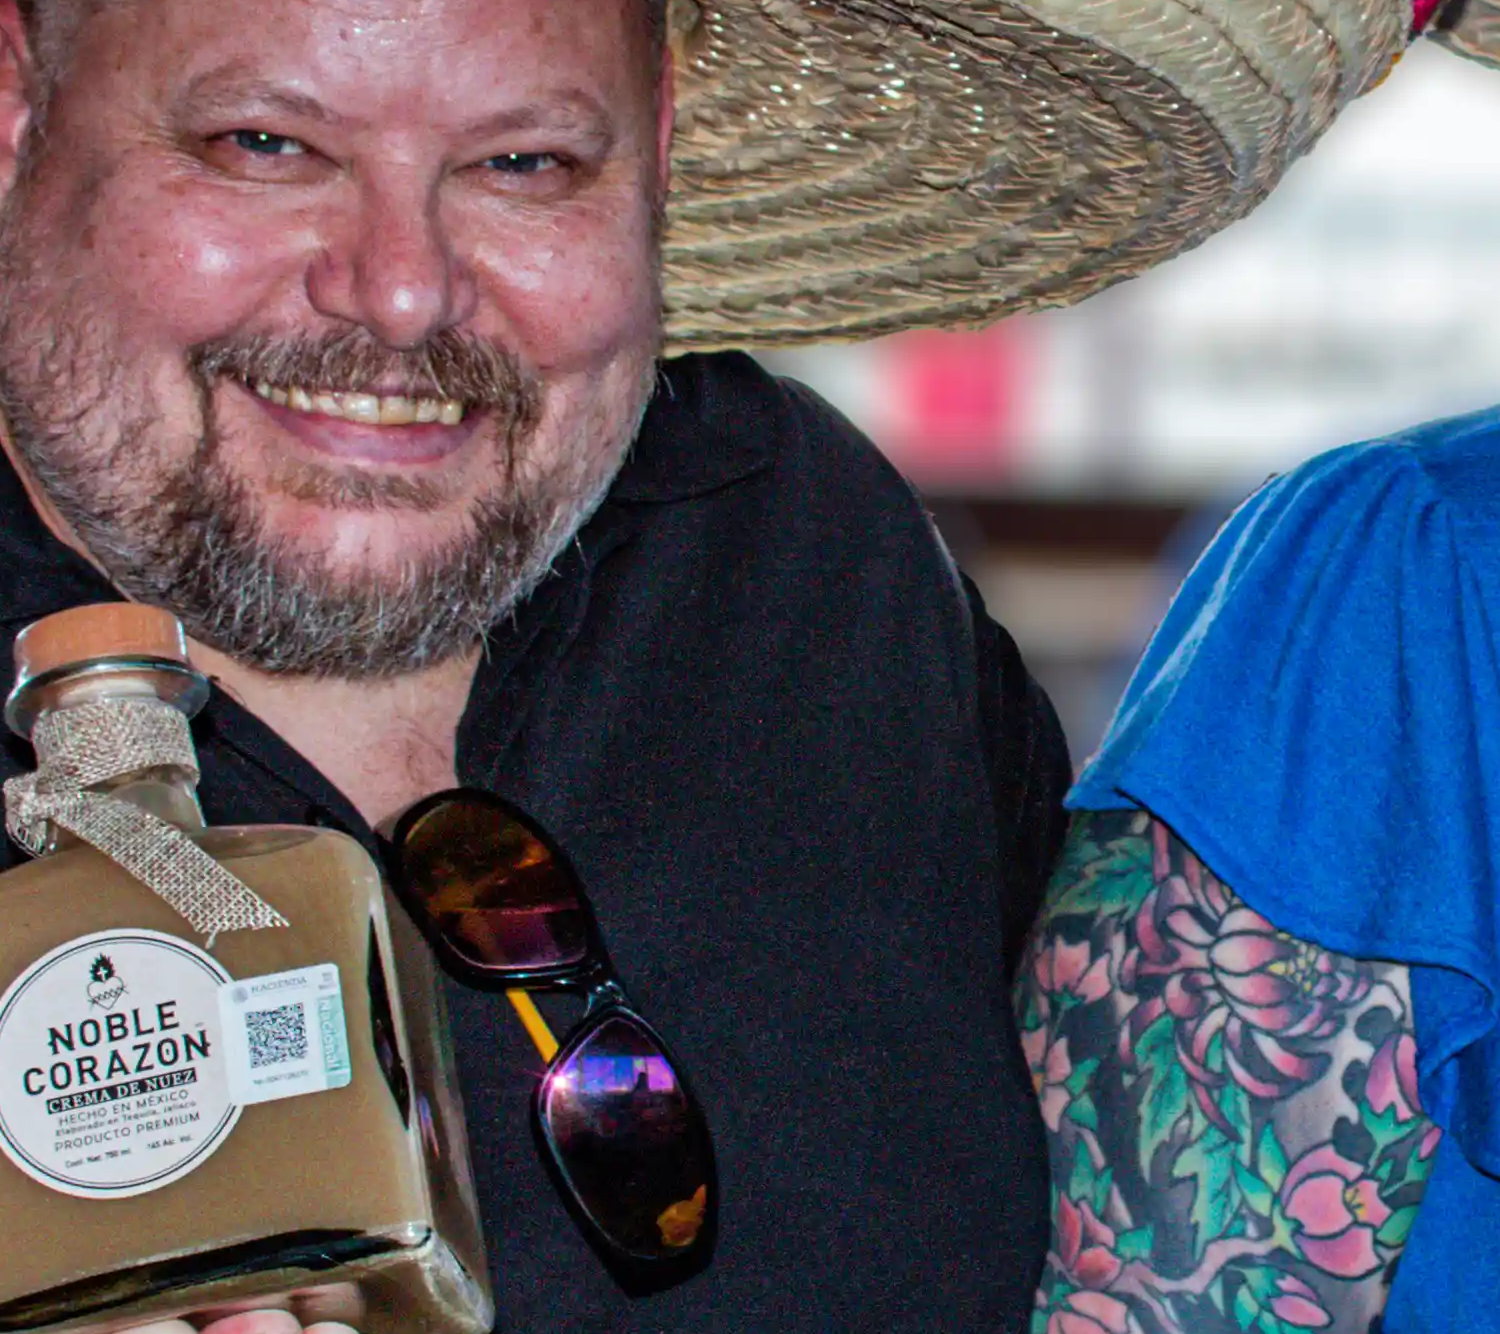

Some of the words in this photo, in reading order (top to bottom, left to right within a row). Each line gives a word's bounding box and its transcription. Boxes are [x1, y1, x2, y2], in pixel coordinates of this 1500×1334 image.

[48, 1000, 179, 1055] NOBLE
[23, 1029, 211, 1096] CORAZON
[49, 1089, 111, 1113] CREMA
[116, 1081, 141, 1098] DE
[146, 1070, 195, 1092] NUEZ
[54, 1127, 131, 1152] PRODUCTO
[136, 1110, 200, 1134] PREMIUM
[58, 1107, 107, 1126] HECHO
[112, 1101, 131, 1115] EN
